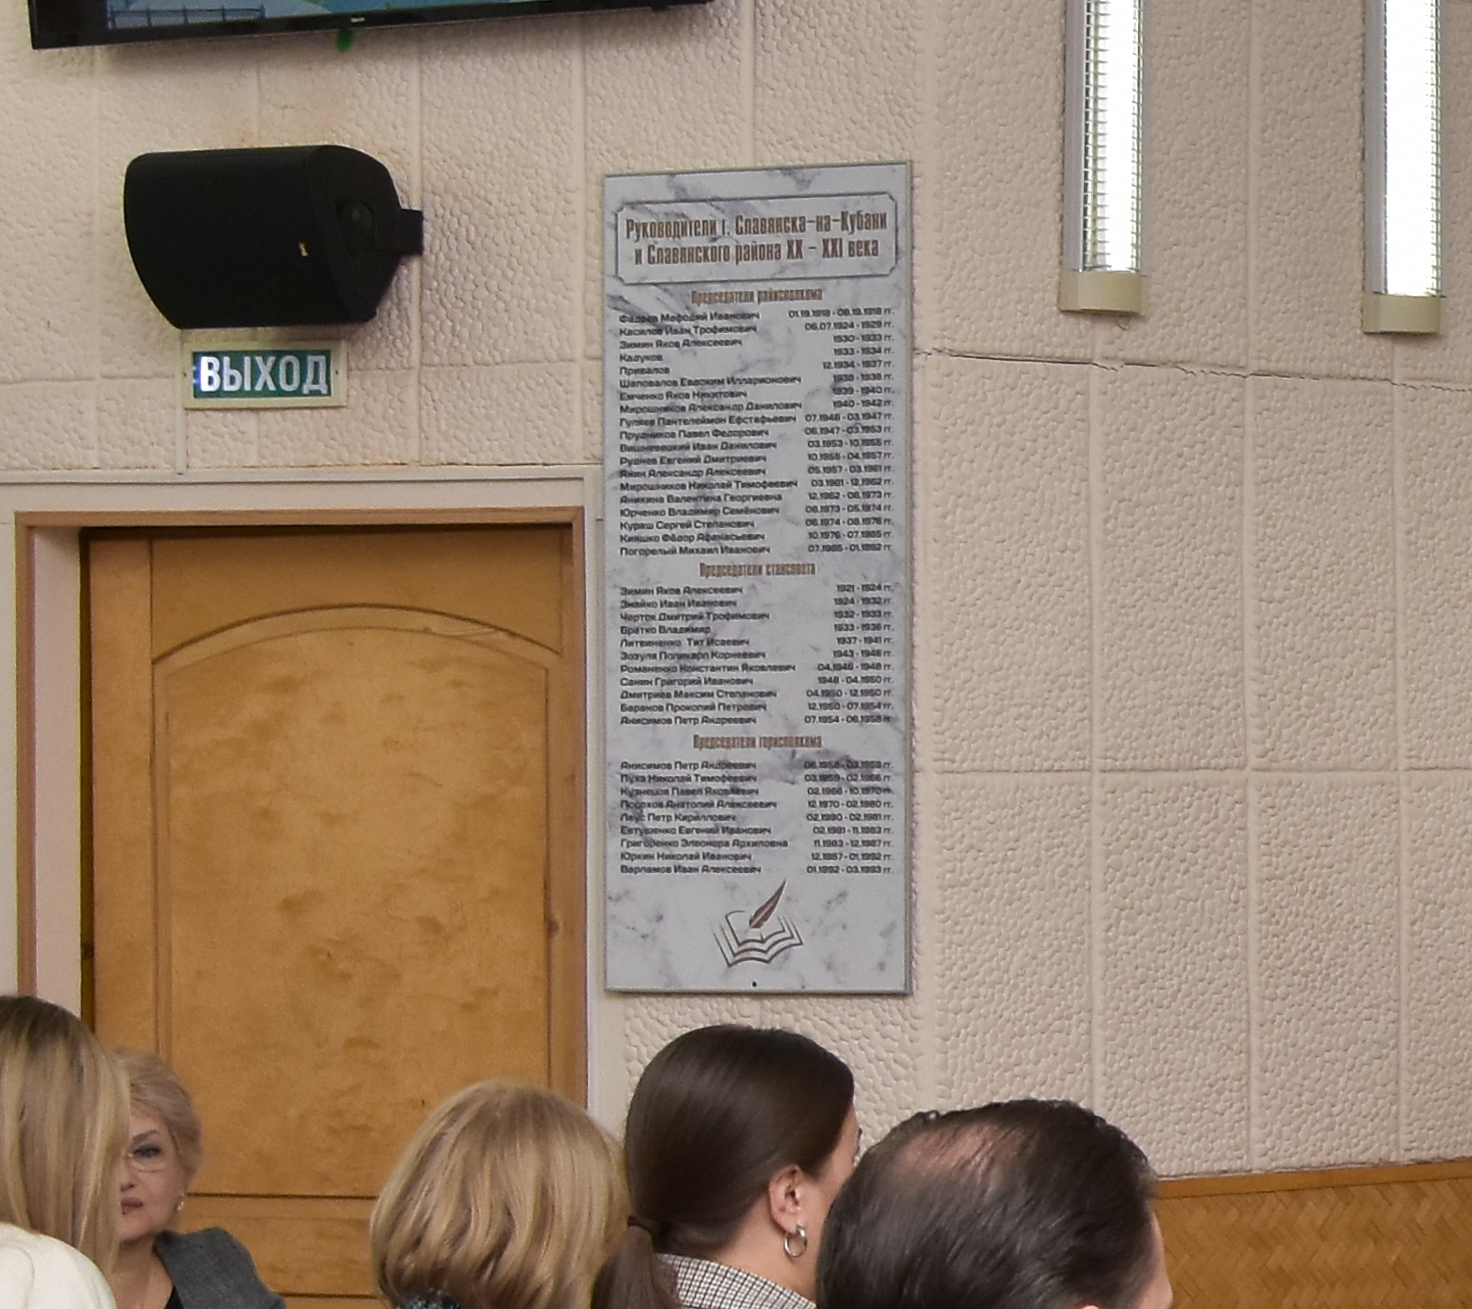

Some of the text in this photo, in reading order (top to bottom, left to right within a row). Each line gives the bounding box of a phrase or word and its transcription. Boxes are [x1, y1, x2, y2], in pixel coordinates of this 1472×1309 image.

[626, 211, 887, 242] Руководители г. Славянска-на-Кубани
[635, 238, 879, 266] и Славянского района XX XXI века
[691, 290, 754, 306] Председатели
[199, 355, 328, 394] ВЫХОД
[678, 430, 710, 438] Павел
[723, 493, 782, 503] Георгиевна
[656, 520, 691, 529] Сергей
[694, 520, 754, 529] Степанович
[721, 546, 770, 554] Иванович
[700, 562, 762, 578] Председатели
[707, 612, 769, 621] Трофимович
[655, 677, 753, 686] Григорий Иванович
[716, 690, 777, 699] Степанович
[718, 703, 766, 712] Петрович
[694, 734, 756, 751] Председатели
